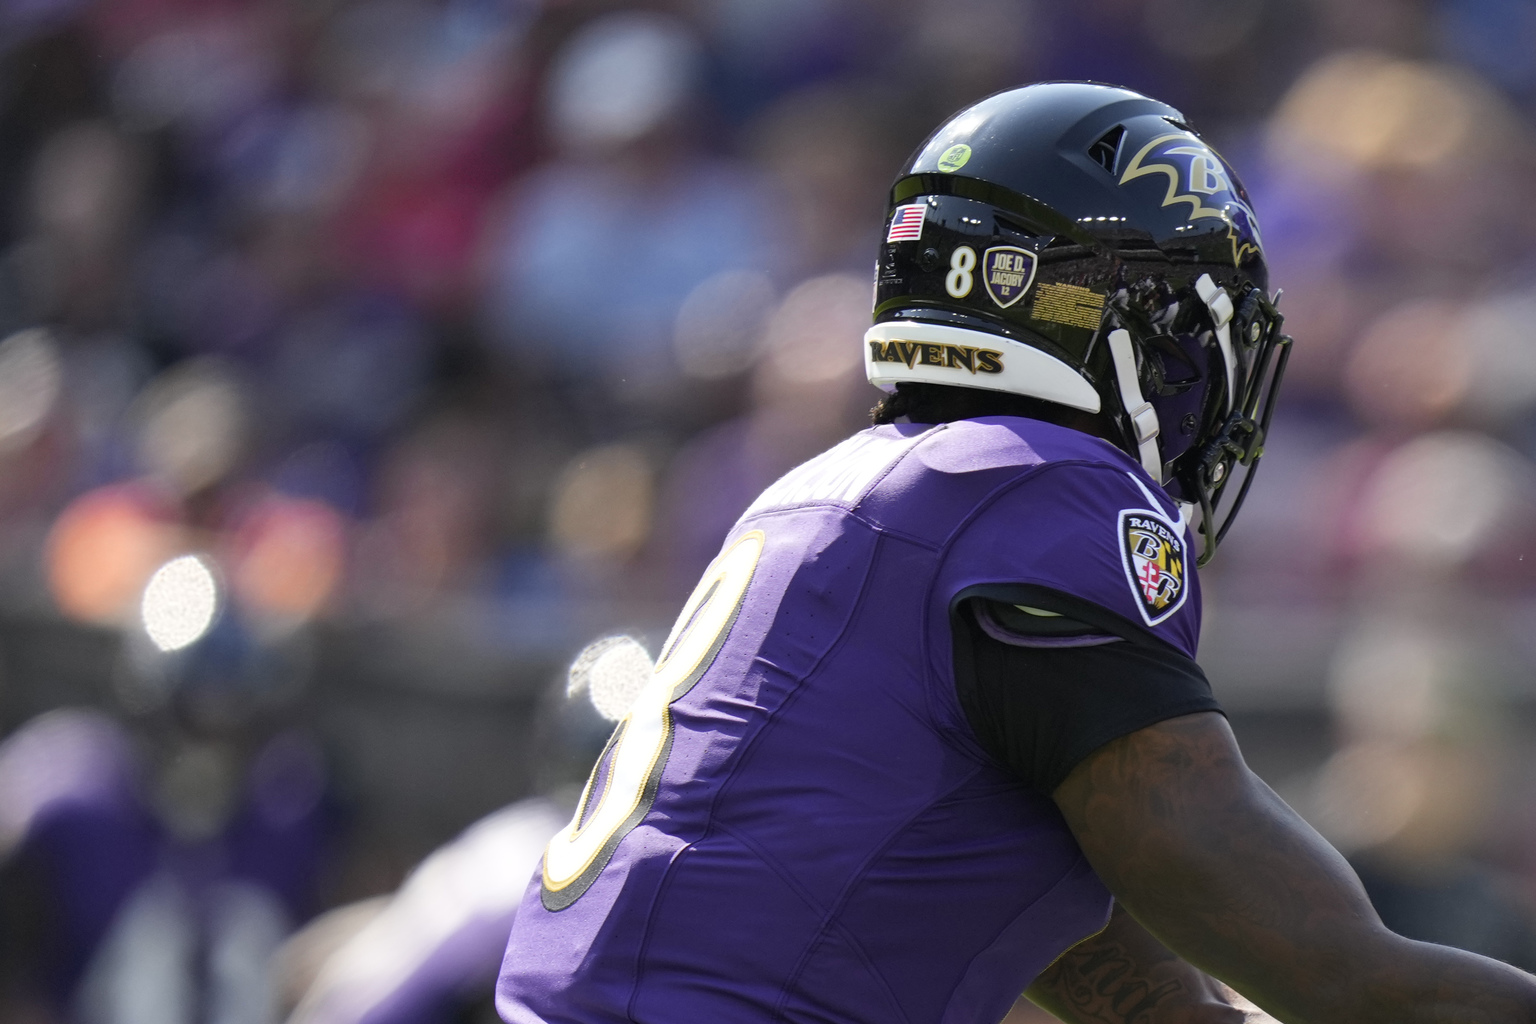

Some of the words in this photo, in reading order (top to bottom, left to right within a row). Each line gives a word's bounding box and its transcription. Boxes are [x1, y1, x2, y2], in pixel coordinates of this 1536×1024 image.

[945, 245, 977, 298] 8
[990, 271, 1025, 288] JACOBY
[992, 252, 1013, 271] JOE
[1013, 256, 1026, 273] D.
[1001, 286, 1010, 296] 12
[869, 338, 1004, 375] RAVENS
[1129, 518, 1181, 552] RAVENS
[541, 530, 765, 912] 8
